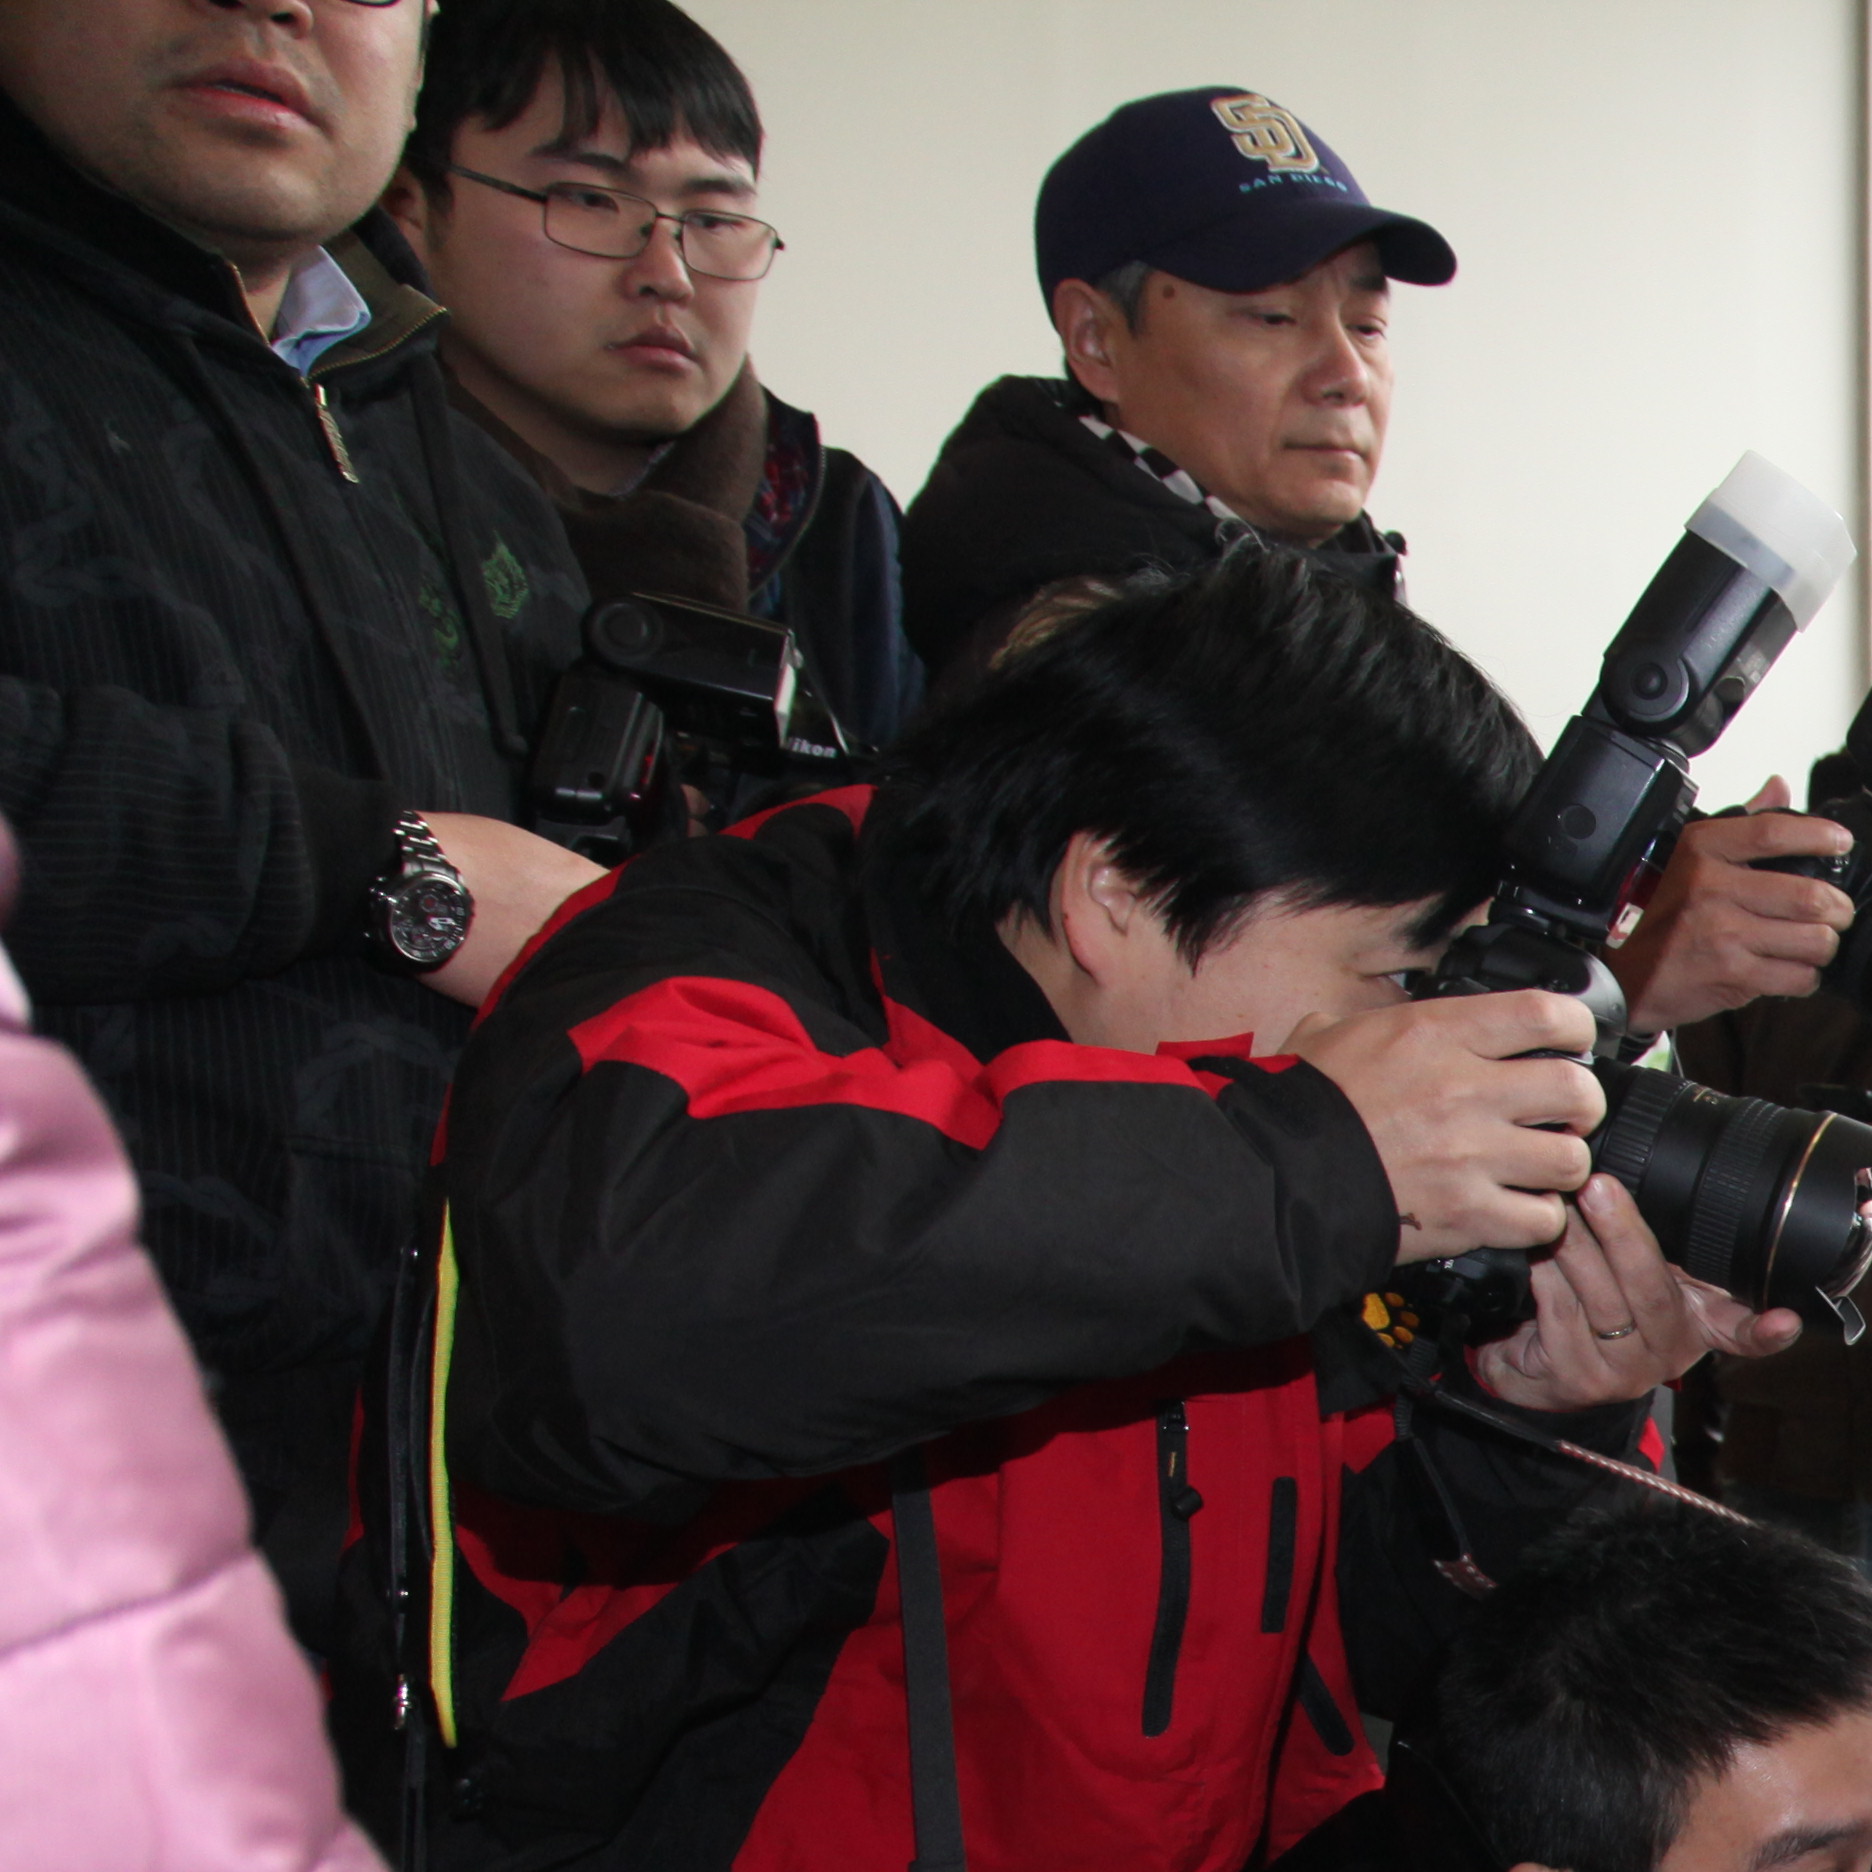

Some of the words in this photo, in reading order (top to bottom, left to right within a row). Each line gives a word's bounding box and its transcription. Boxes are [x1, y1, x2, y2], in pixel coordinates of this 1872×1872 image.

[1239, 174, 1283, 193] SAN
[1290, 173, 1348, 193] DIEGO
[788, 736, 837, 758] ikon
